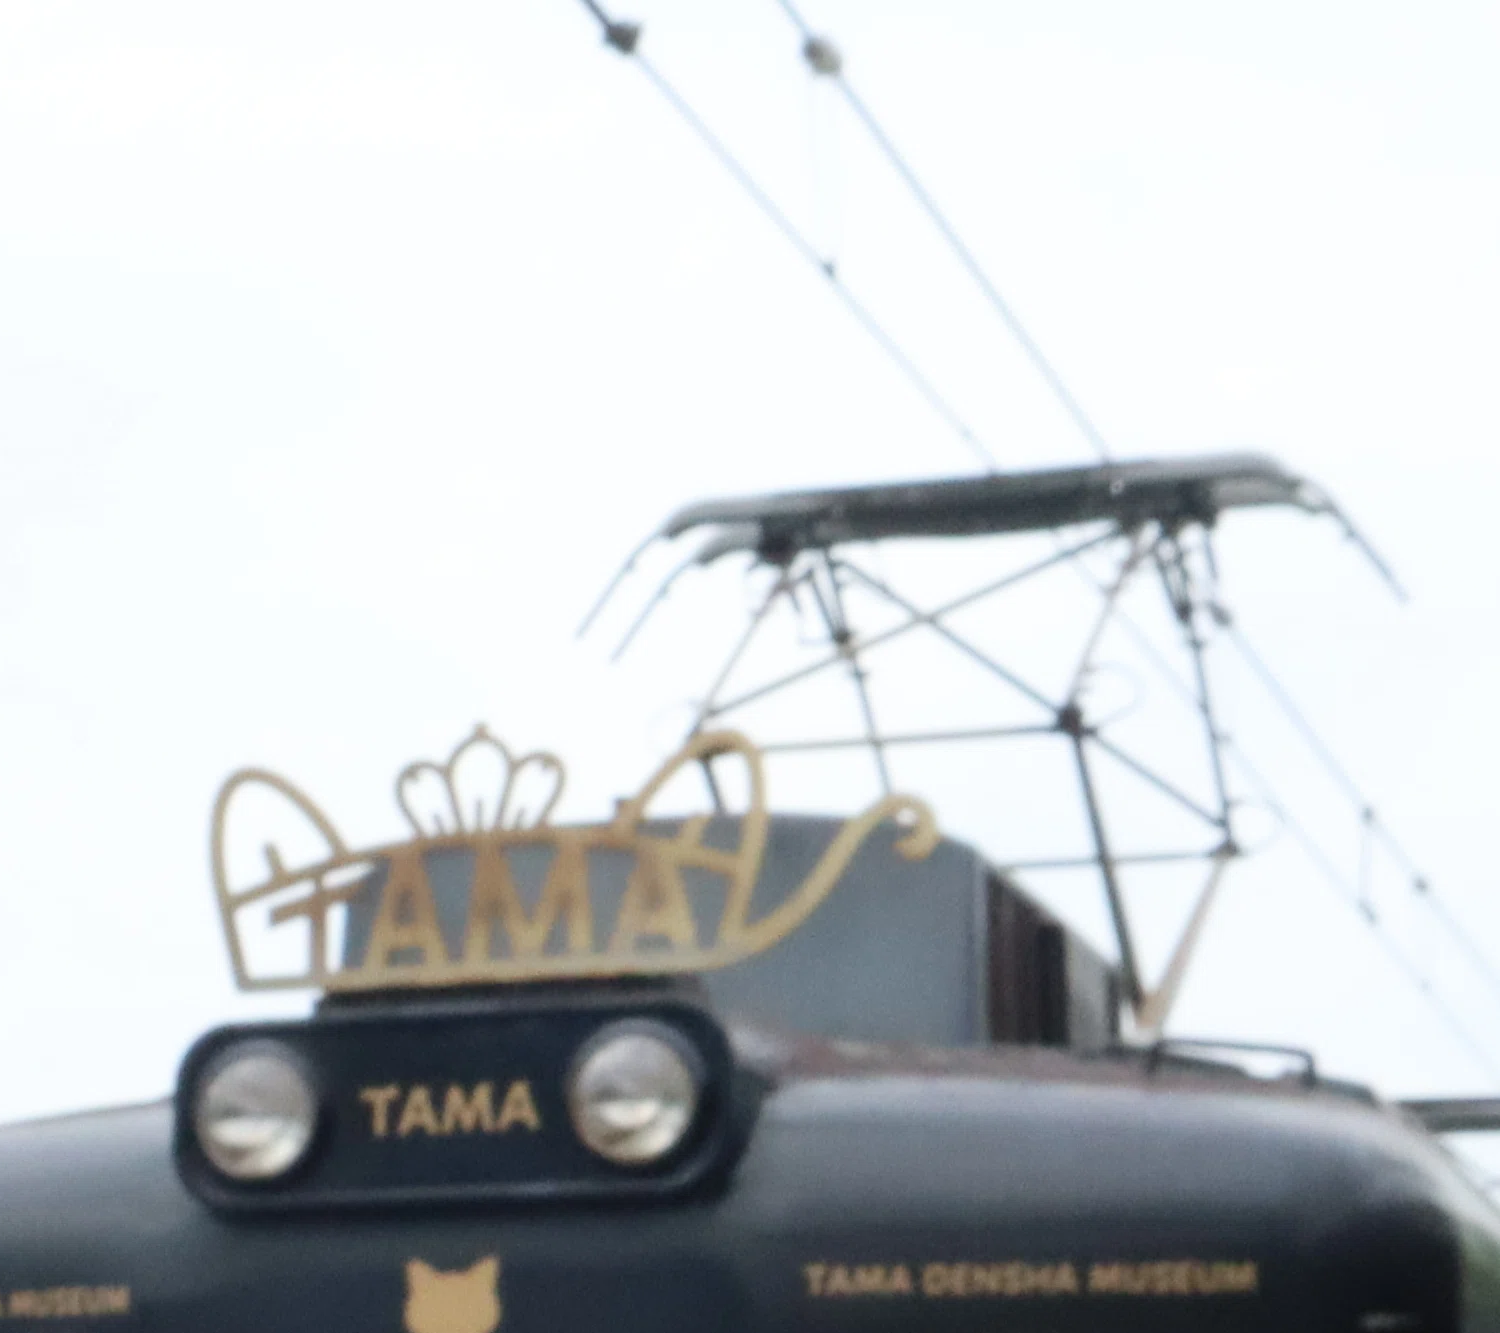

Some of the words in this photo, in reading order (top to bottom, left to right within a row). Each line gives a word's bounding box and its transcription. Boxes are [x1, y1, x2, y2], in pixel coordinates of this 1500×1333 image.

[358, 1075, 541, 1138] TAMA
[806, 1262, 912, 1296] TAMA
[922, 1262, 1078, 1296] DENSHA
[1089, 1260, 1258, 1295] MUSEUM
[8, 1285, 132, 1317] MUSEUM
